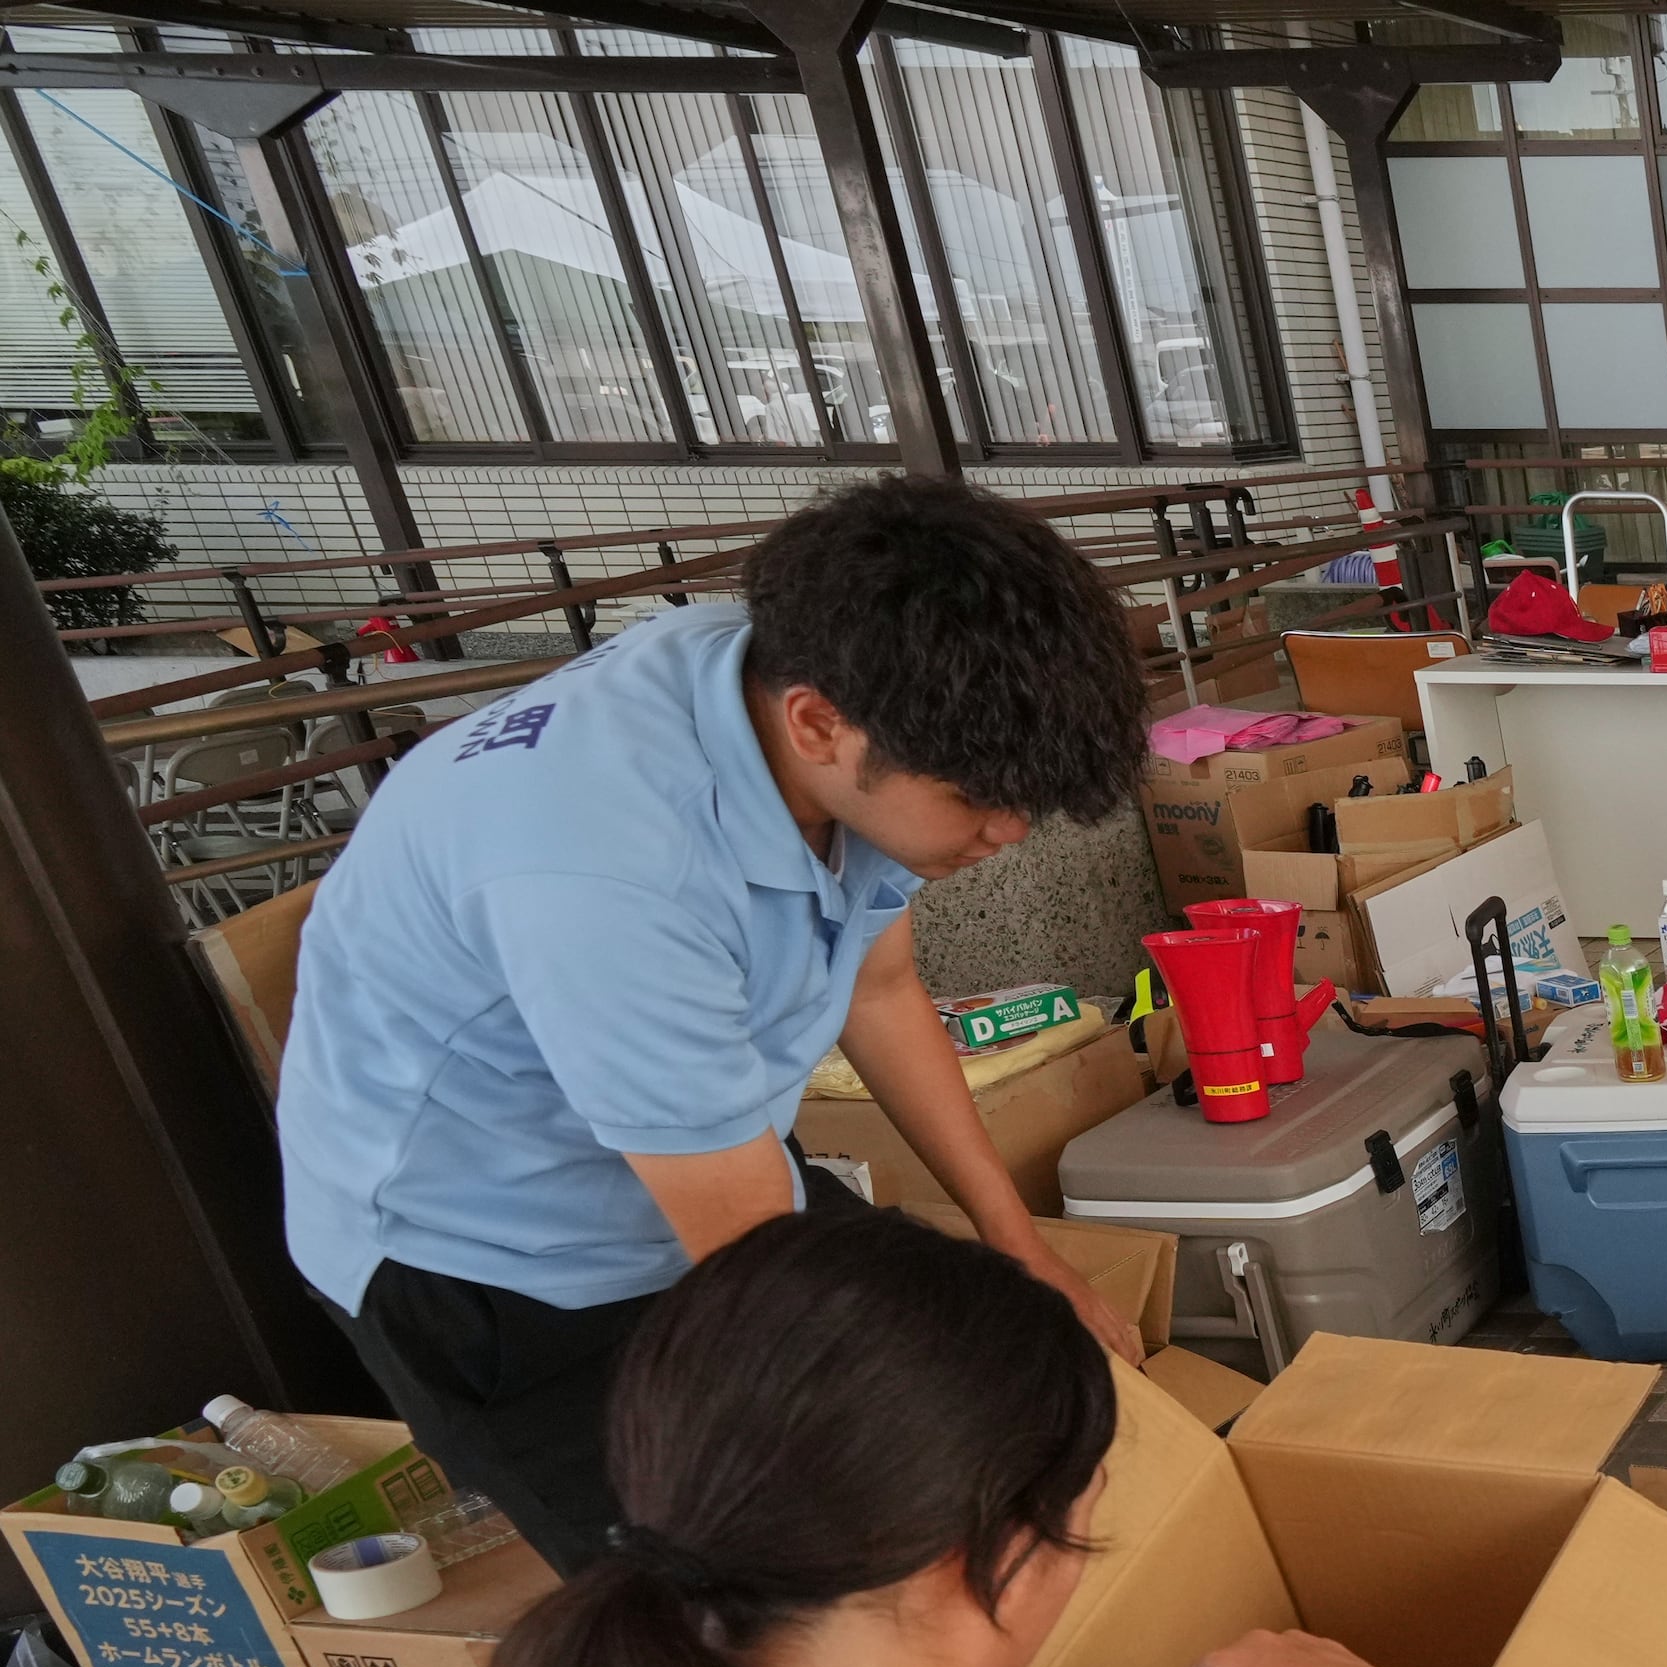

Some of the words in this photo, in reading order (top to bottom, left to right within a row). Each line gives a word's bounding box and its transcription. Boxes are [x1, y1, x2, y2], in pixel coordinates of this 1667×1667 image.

[1225, 768, 1260, 781] 21403
[1153, 800, 1221, 826] moony
[995, 999, 1043, 1016] サバイバルパン
[1052, 996, 1075, 1022] A
[971, 1016, 995, 1042] D
[78, 1584, 227, 1618] 2025シーズン
[123, 1616, 215, 1647] 55+8本
